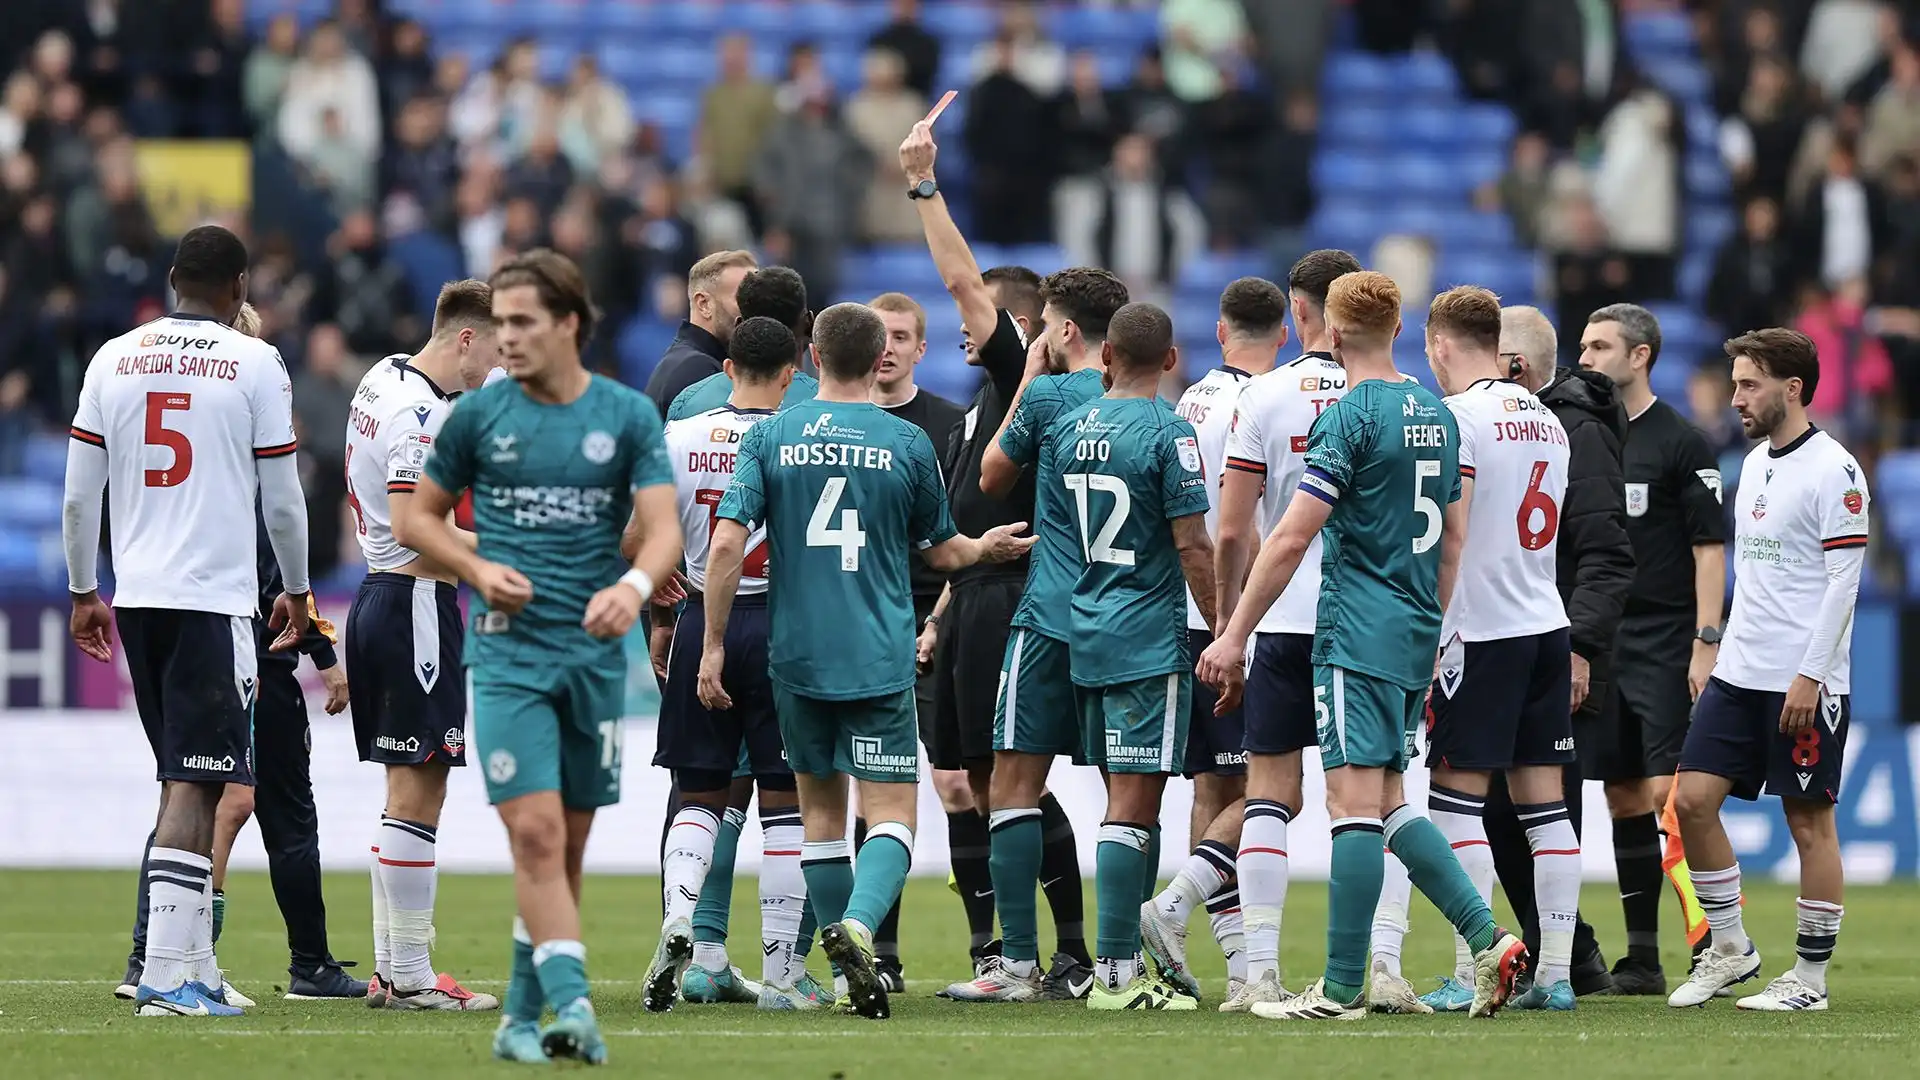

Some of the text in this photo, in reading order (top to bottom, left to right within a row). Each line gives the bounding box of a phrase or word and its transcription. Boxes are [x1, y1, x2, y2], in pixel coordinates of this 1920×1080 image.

[140, 333, 219, 350] ebuyer
[116, 354, 239, 381] ALMEIDA SANTOS
[144, 391, 193, 488] 5
[1076, 439, 1110, 462] OJO
[1403, 424, 1448, 448] FEENEY
[780, 442, 892, 471] ROSSITER
[1062, 473, 1136, 566] 12
[1412, 460, 1443, 554] 5
[1516, 460, 1558, 551] 6
[805, 476, 866, 572] 4
[1313, 684, 1330, 729] 5
[183, 754, 222, 771] utilita
[865, 753, 917, 767] HANMART
[1791, 727, 1821, 767] 8
